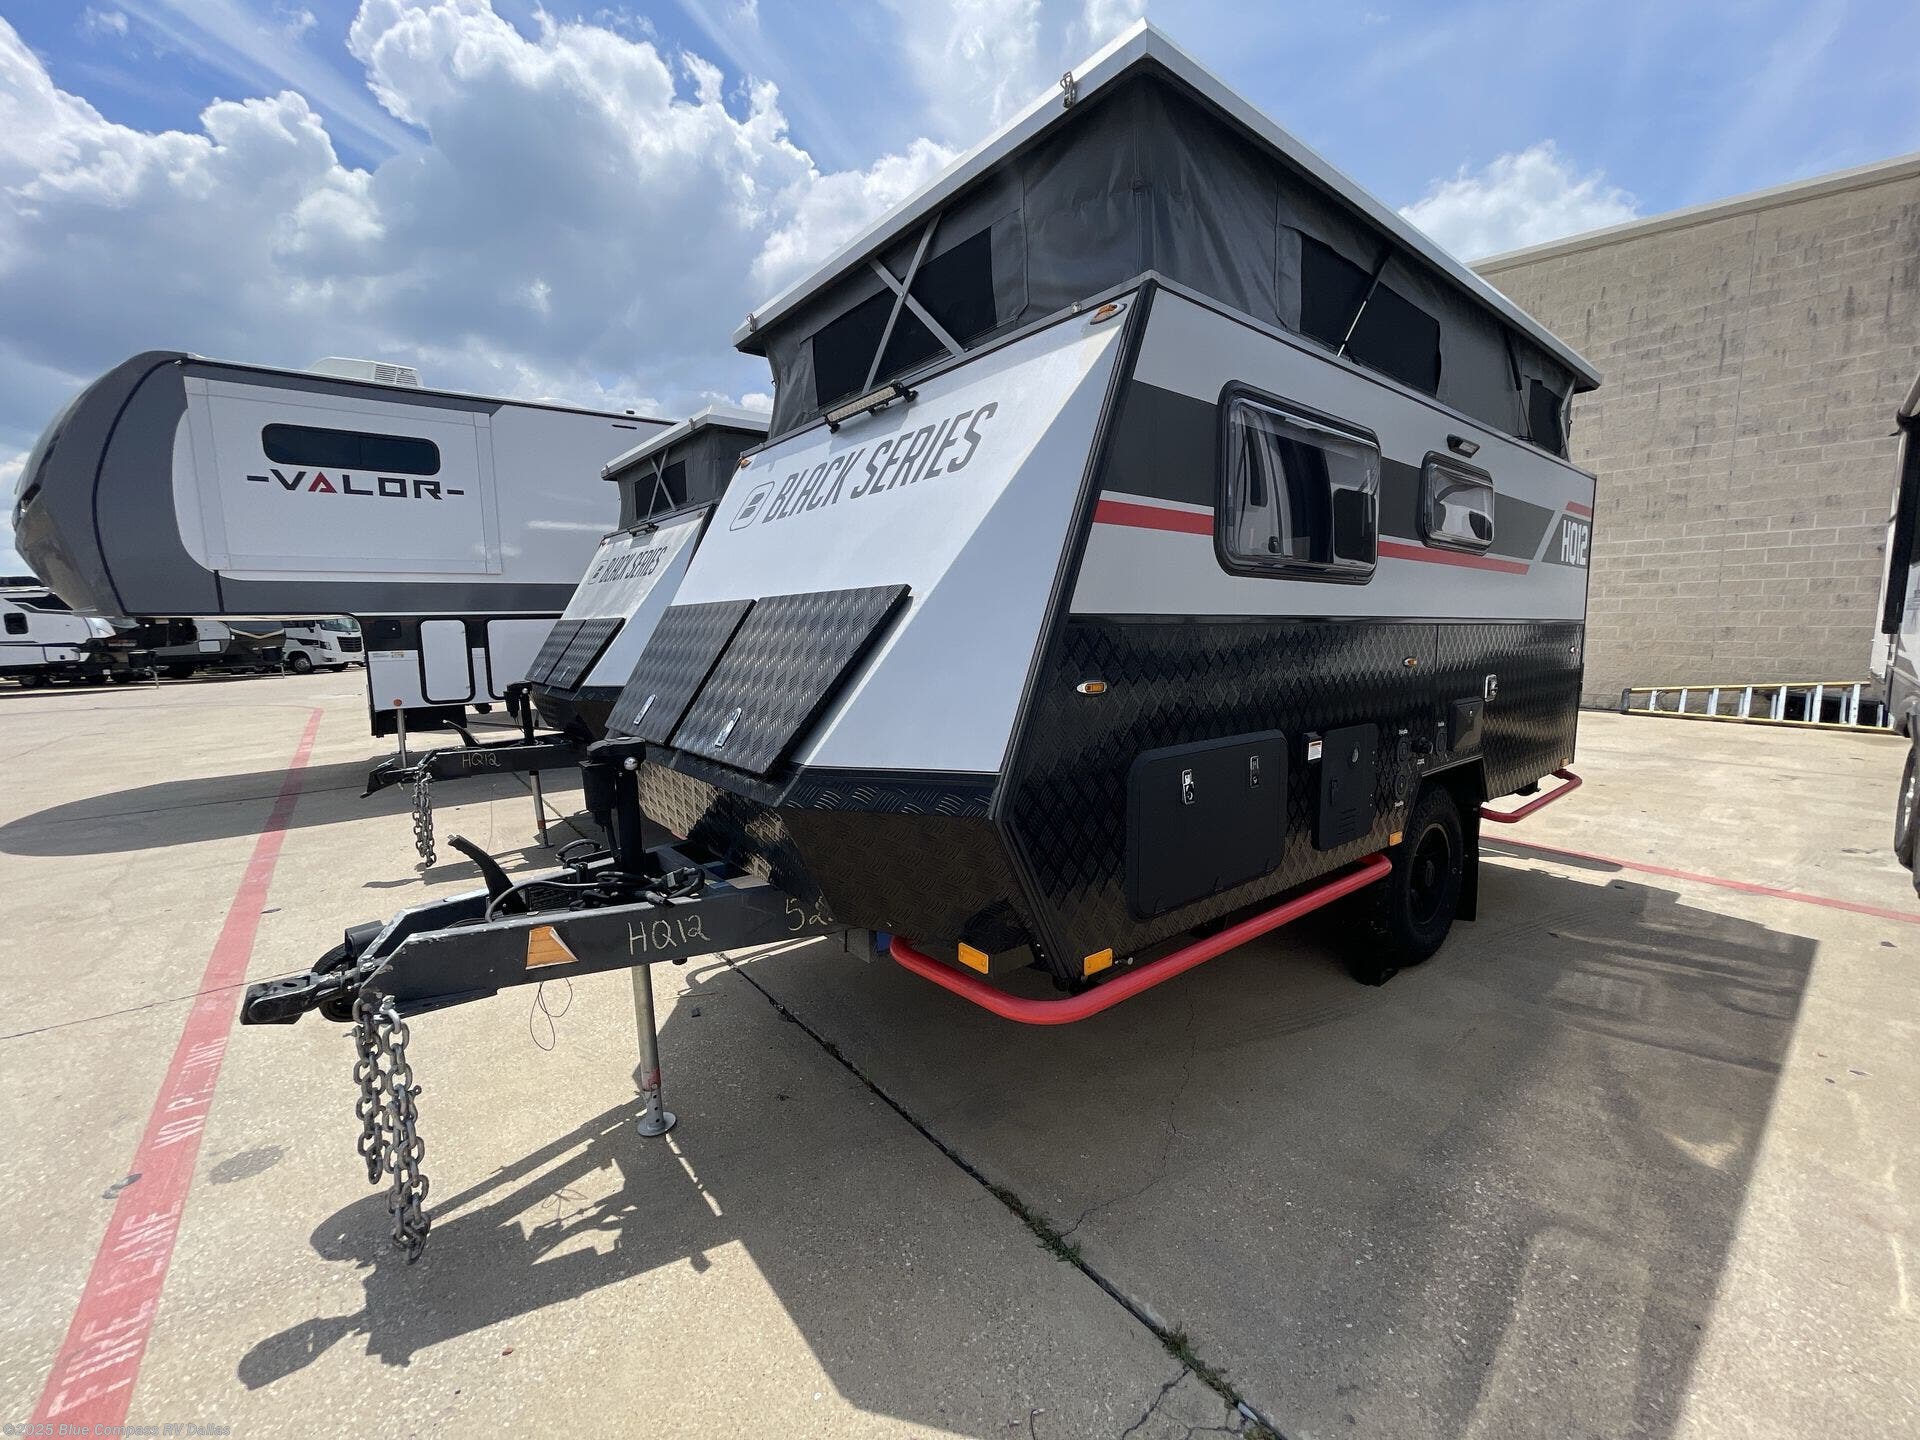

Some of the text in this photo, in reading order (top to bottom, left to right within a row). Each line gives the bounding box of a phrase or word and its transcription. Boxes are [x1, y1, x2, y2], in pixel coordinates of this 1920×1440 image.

[761, 401, 999, 524] BLACK SERIES
[624, 546, 668, 580] SERIES
[462, 752, 502, 769] HQ12
[627, 914, 712, 956] HQ12
[46, 1036, 228, 1418] FIRE LANE NO PING
